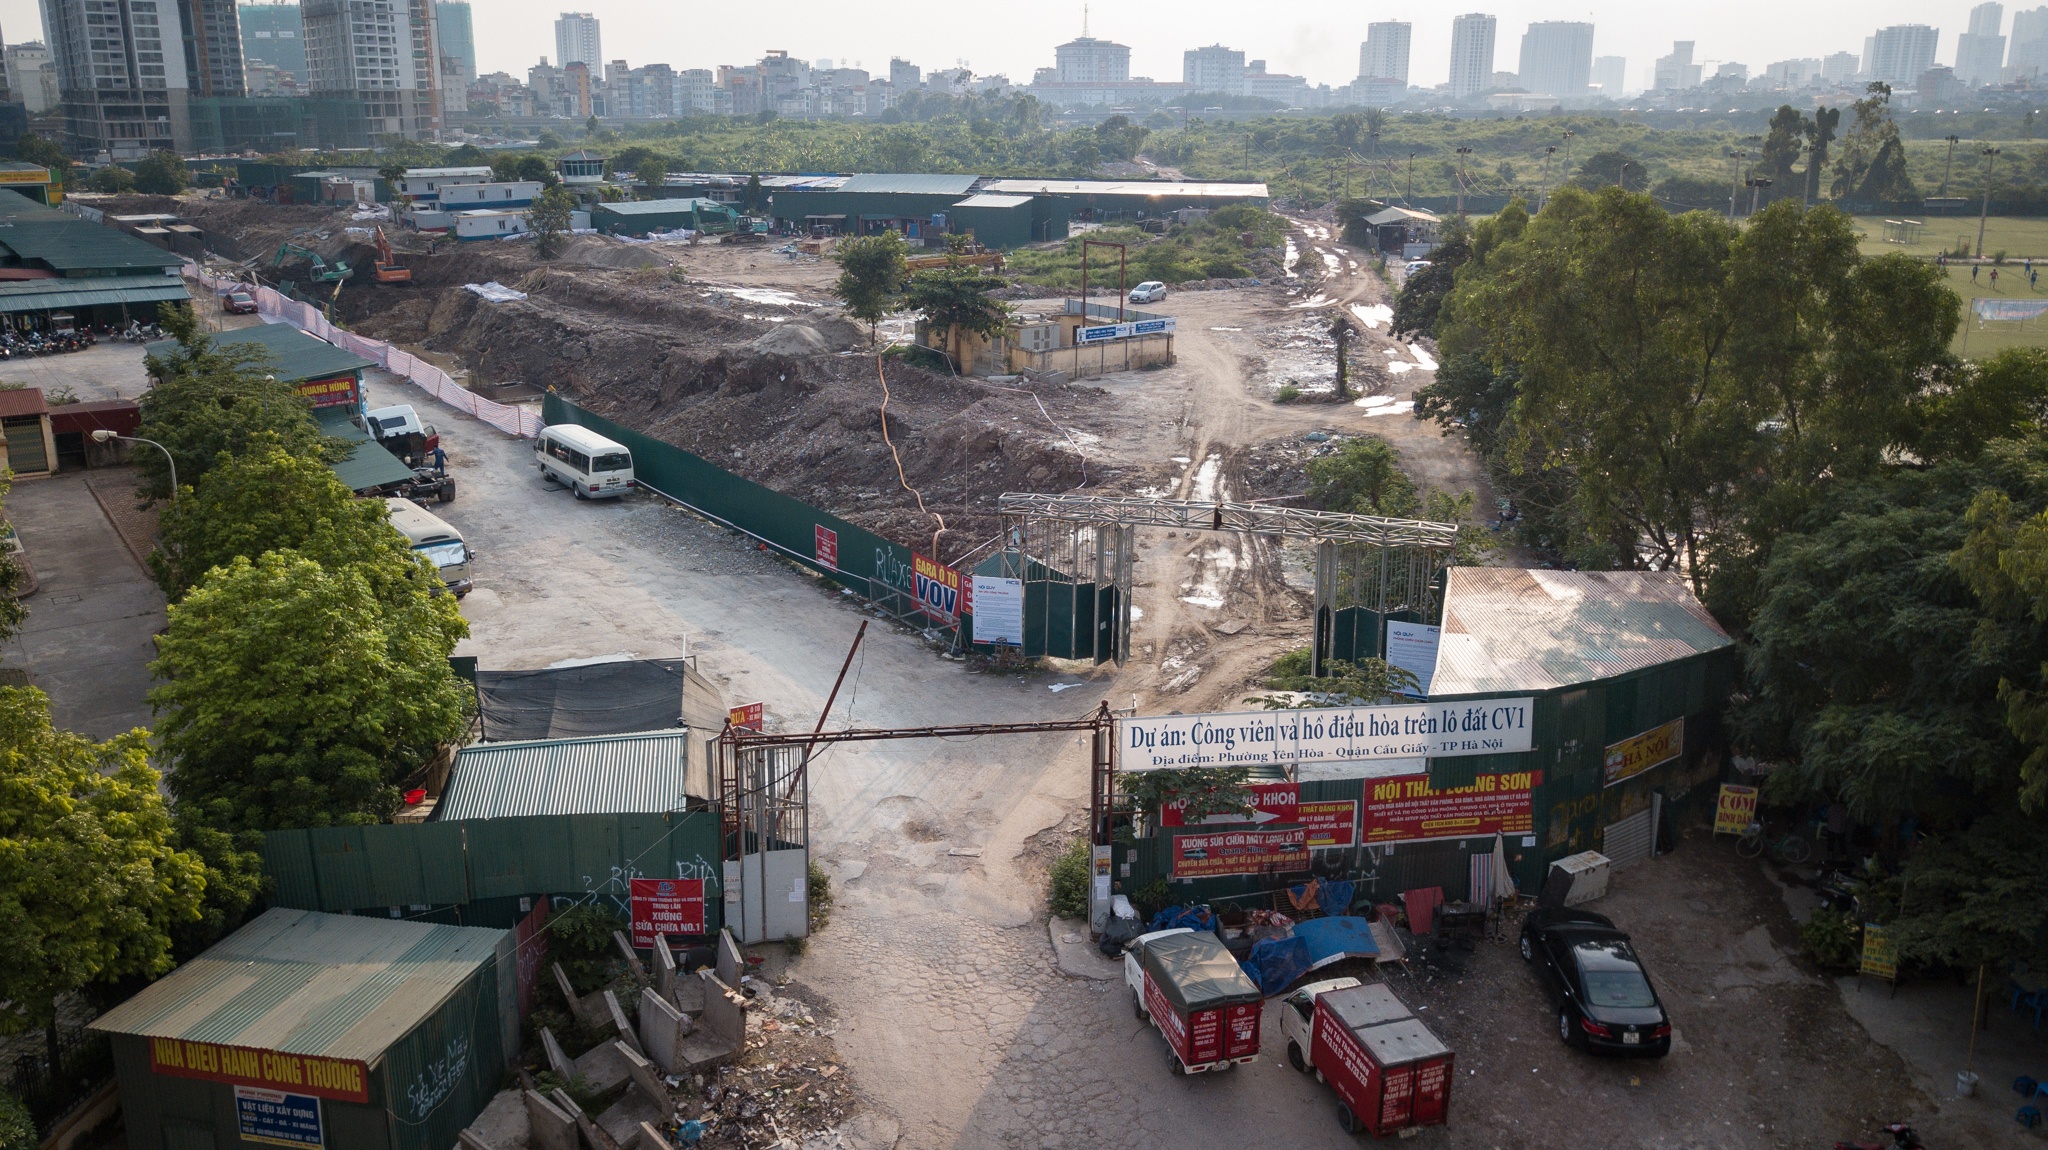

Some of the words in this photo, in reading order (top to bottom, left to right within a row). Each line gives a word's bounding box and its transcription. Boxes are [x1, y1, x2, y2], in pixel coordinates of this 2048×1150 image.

[302, 384, 327, 396] QUANG
[329, 381, 350, 392] HÙNG
[916, 558, 937, 580] GARA
[939, 565, 945, 583] Ô
[947, 571, 958, 589] TÔ
[916, 572, 958, 616] VOV
[731, 708, 746, 725] RỬA
[1130, 726, 1157, 753] Dự
[1161, 724, 1186, 747] án:
[1192, 722, 1235, 751] Công
[1239, 719, 1275, 743] viên
[1280, 718, 1298, 741] và
[1302, 714, 1324, 740] hồ
[1328, 714, 1364, 738] điều
[1369, 714, 1400, 737] hòa
[1404, 712, 1437, 735] trên
[1442, 710, 1457, 733] lô
[1462, 706, 1488, 732] đất
[1492, 706, 1524, 730] CV1
[1153, 756, 1174, 767] Địa
[1218, 750, 1268, 763] Phường
[1272, 750, 1294, 760] Yên
[1300, 748, 1324, 758] Hòa
[1336, 746, 1369, 758] Quận
[1401, 742, 1429, 755] Giấy
[1440, 742, 1458, 751] TP
[1461, 740, 1478, 750] Hà
[1482, 738, 1503, 750] Nội
[1622, 746, 1642, 768] HÀ
[1646, 736, 1669, 758] NỘI
[1374, 780, 1401, 803] NỘI
[1500, 772, 1532, 791] SƠN
[1263, 792, 1296, 806] KHOA
[1720, 794, 1755, 811] CƠM
[1303, 804, 1318, 813] THẤT
[1718, 810, 1736, 823] BÌNH
[1246, 833, 1263, 845] MÁY
[1286, 832, 1292, 842] Ô
[1295, 831, 1304, 842] TÔ
[652, 910, 682, 921] XƯỞNG
[635, 920, 653, 931] SỬA
[655, 922, 678, 932] CHỮA
[680, 923, 700, 932] NO.1
[1323, 1018, 1334, 1035] Taxi
[1342, 1040, 1356, 1061] Thành
[220, 1045, 260, 1079] HÀNH
[263, 1050, 302, 1085] CÔNG
[304, 1057, 362, 1093] TRƯỜNG
[242, 1101, 256, 1112] VẬT
[258, 1103, 275, 1114] LIỆU
[276, 1106, 292, 1116] XÂY
[292, 1109, 315, 1120] DỰNG
